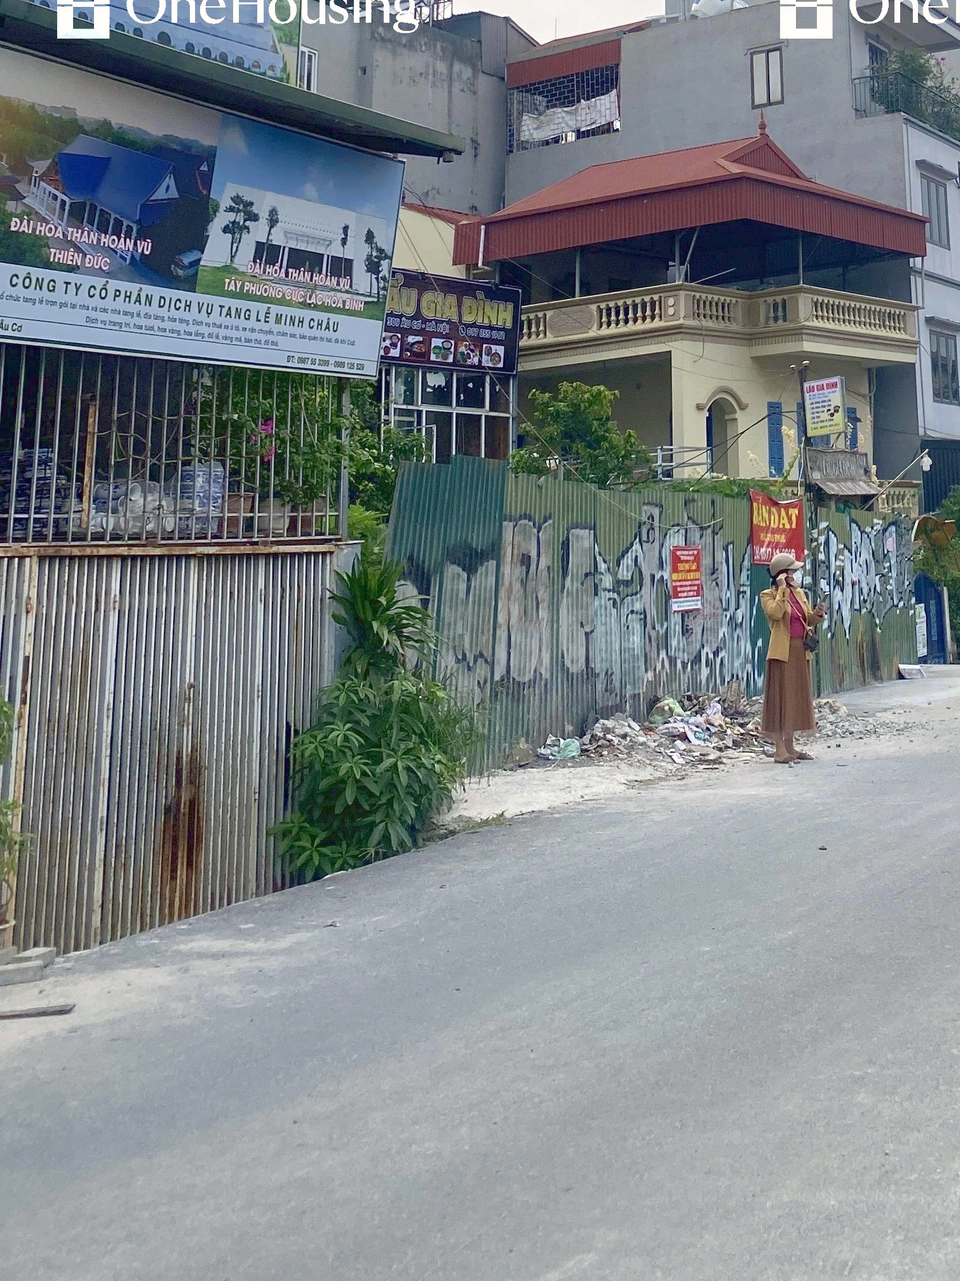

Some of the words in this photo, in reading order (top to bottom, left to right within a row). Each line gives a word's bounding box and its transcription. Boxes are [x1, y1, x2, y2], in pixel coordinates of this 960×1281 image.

[10, 216, 32, 233] ĐÀI
[36, 219, 63, 240] HÓA
[67, 226, 98, 245] THÂN
[101, 232, 134, 251] HOÀN
[137, 239, 152, 255] VŨ
[50, 248, 82, 266] THIÊN
[85, 253, 110, 270] ĐỨC
[248, 260, 264, 275] ĐÀI
[288, 268, 311, 283] THÂN
[313, 271, 337, 287] HOÀN
[10, 272, 57, 293] CÔNG
[63, 282, 83, 297] TY
[88, 280, 110, 300] CỔ
[113, 287, 153, 308] PHẦN
[158, 295, 192, 313] DỊCH
[197, 301, 214, 318] VỤ
[219, 305, 251, 321] TANG
[256, 307, 272, 323] LỄ
[274, 313, 305, 329] MINH
[309, 317, 340, 333] CHÂU
[23, 296, 37, 306] tang
[224, 277, 242, 292] TÂY
[244, 283, 283, 299] PHƯƠNG
[345, 297, 365, 312] BÌNH
[386, 273, 418, 316] ẨU
[420, 290, 459, 323] GIA
[462, 291, 514, 329] ĐÌNH
[11, 323, 23, 332] Cơ
